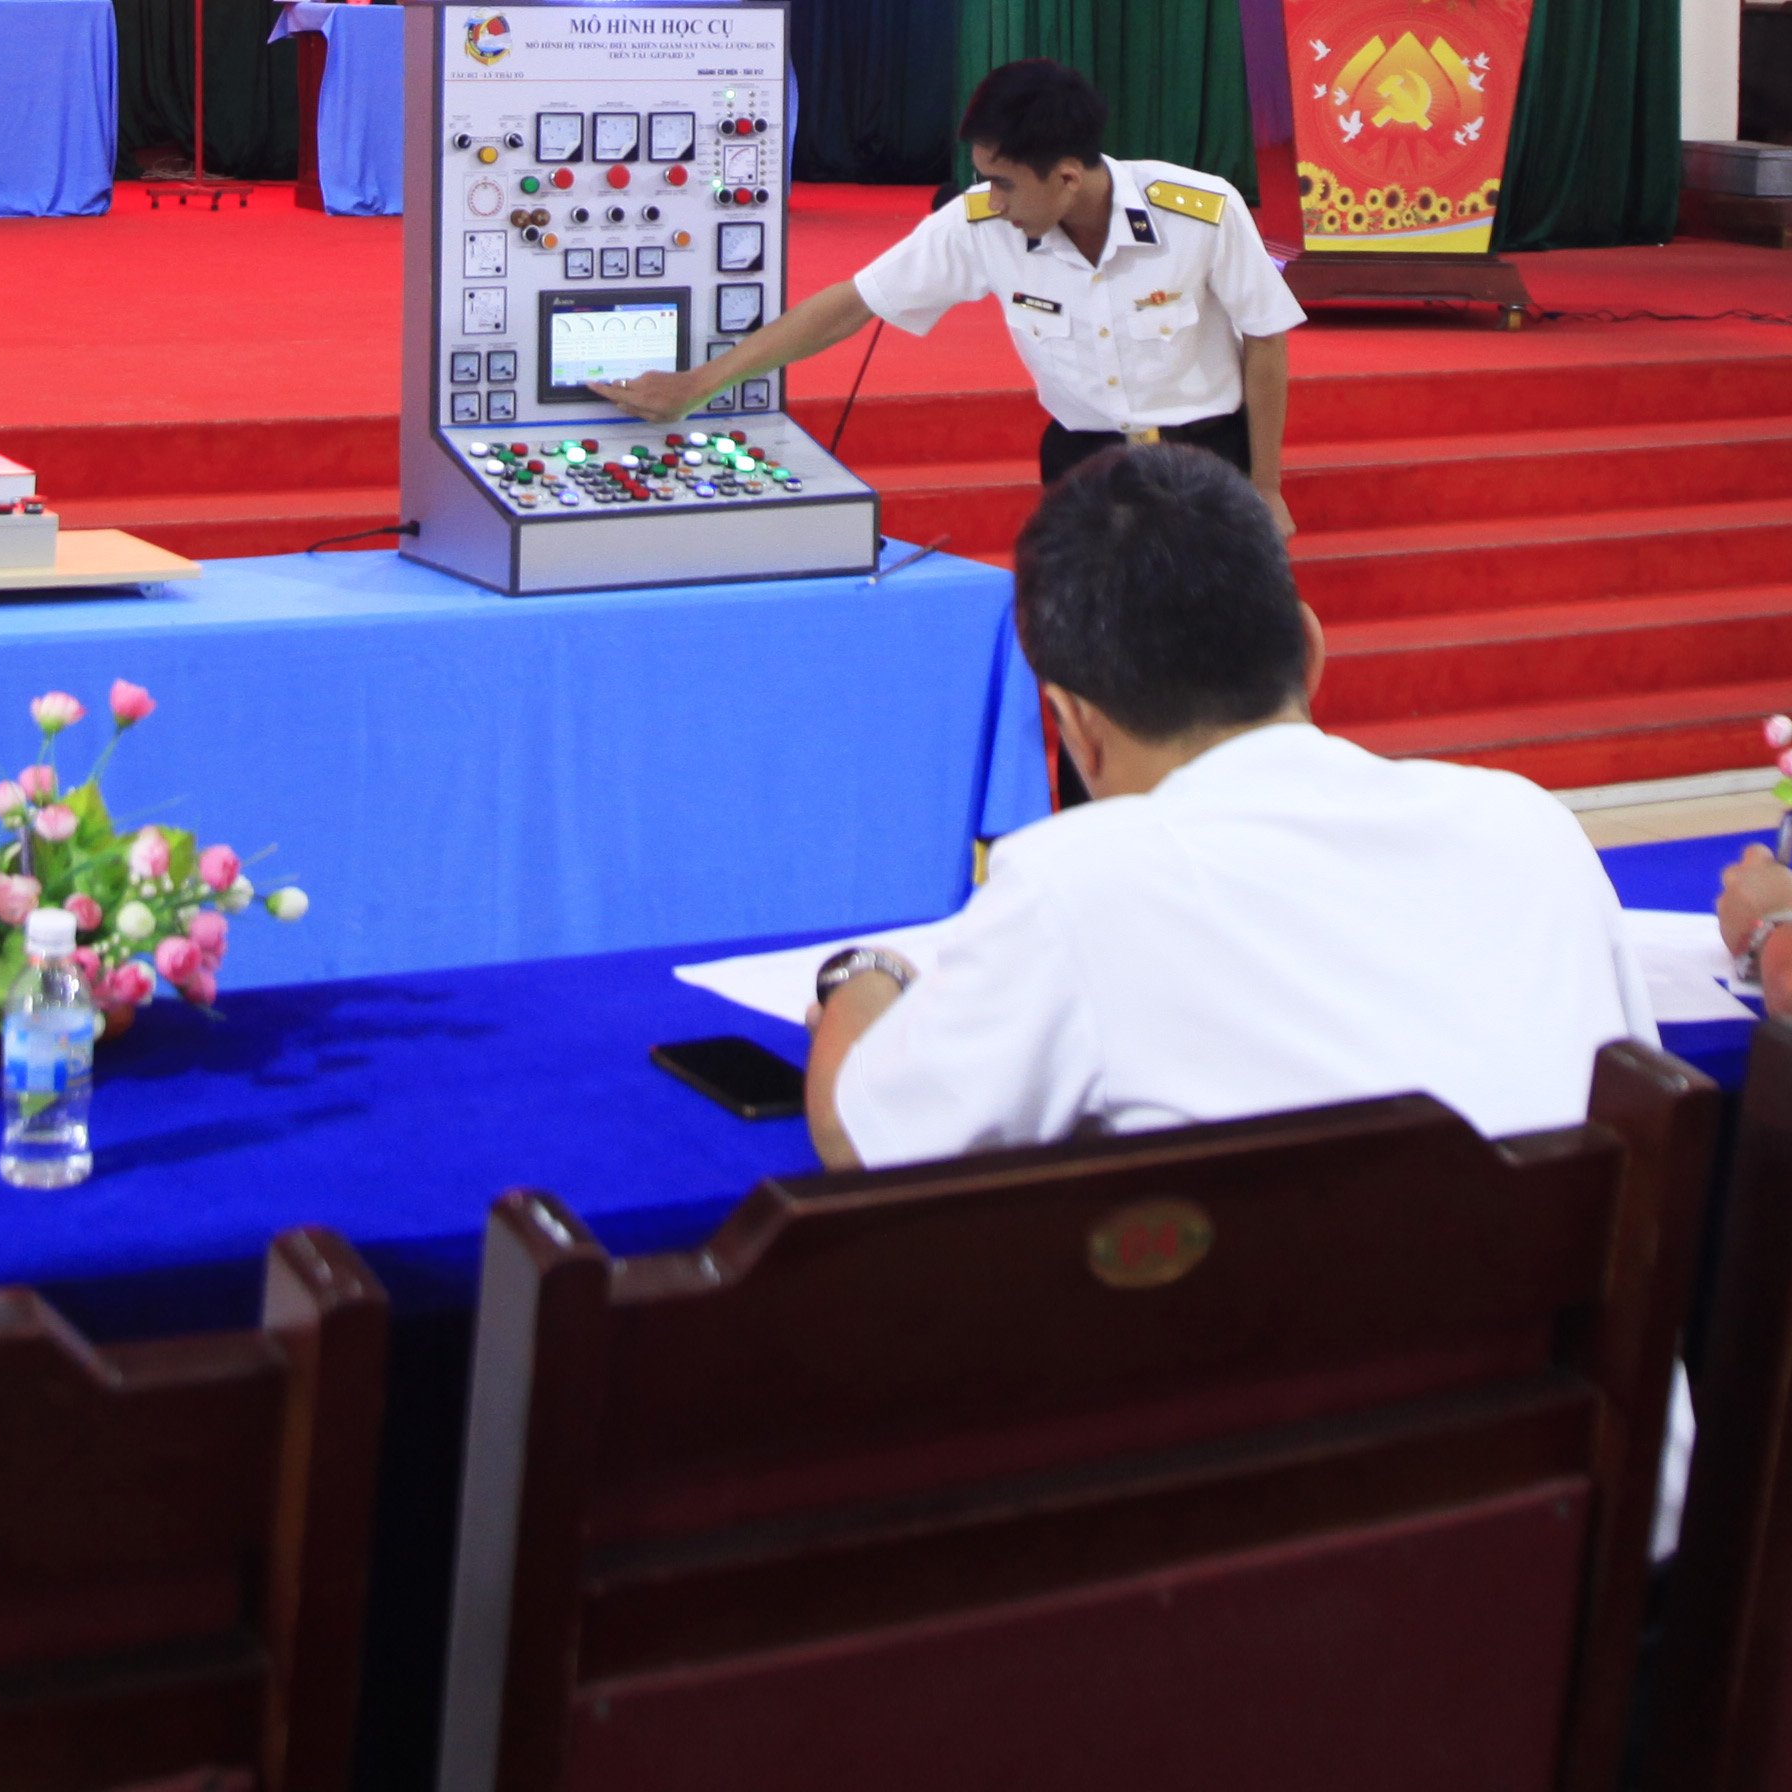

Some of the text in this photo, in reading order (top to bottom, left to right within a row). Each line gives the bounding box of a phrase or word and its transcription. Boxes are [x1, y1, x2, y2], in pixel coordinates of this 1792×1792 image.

[570, 14, 734, 38] MÔ HÌNH HỌC CỤ
